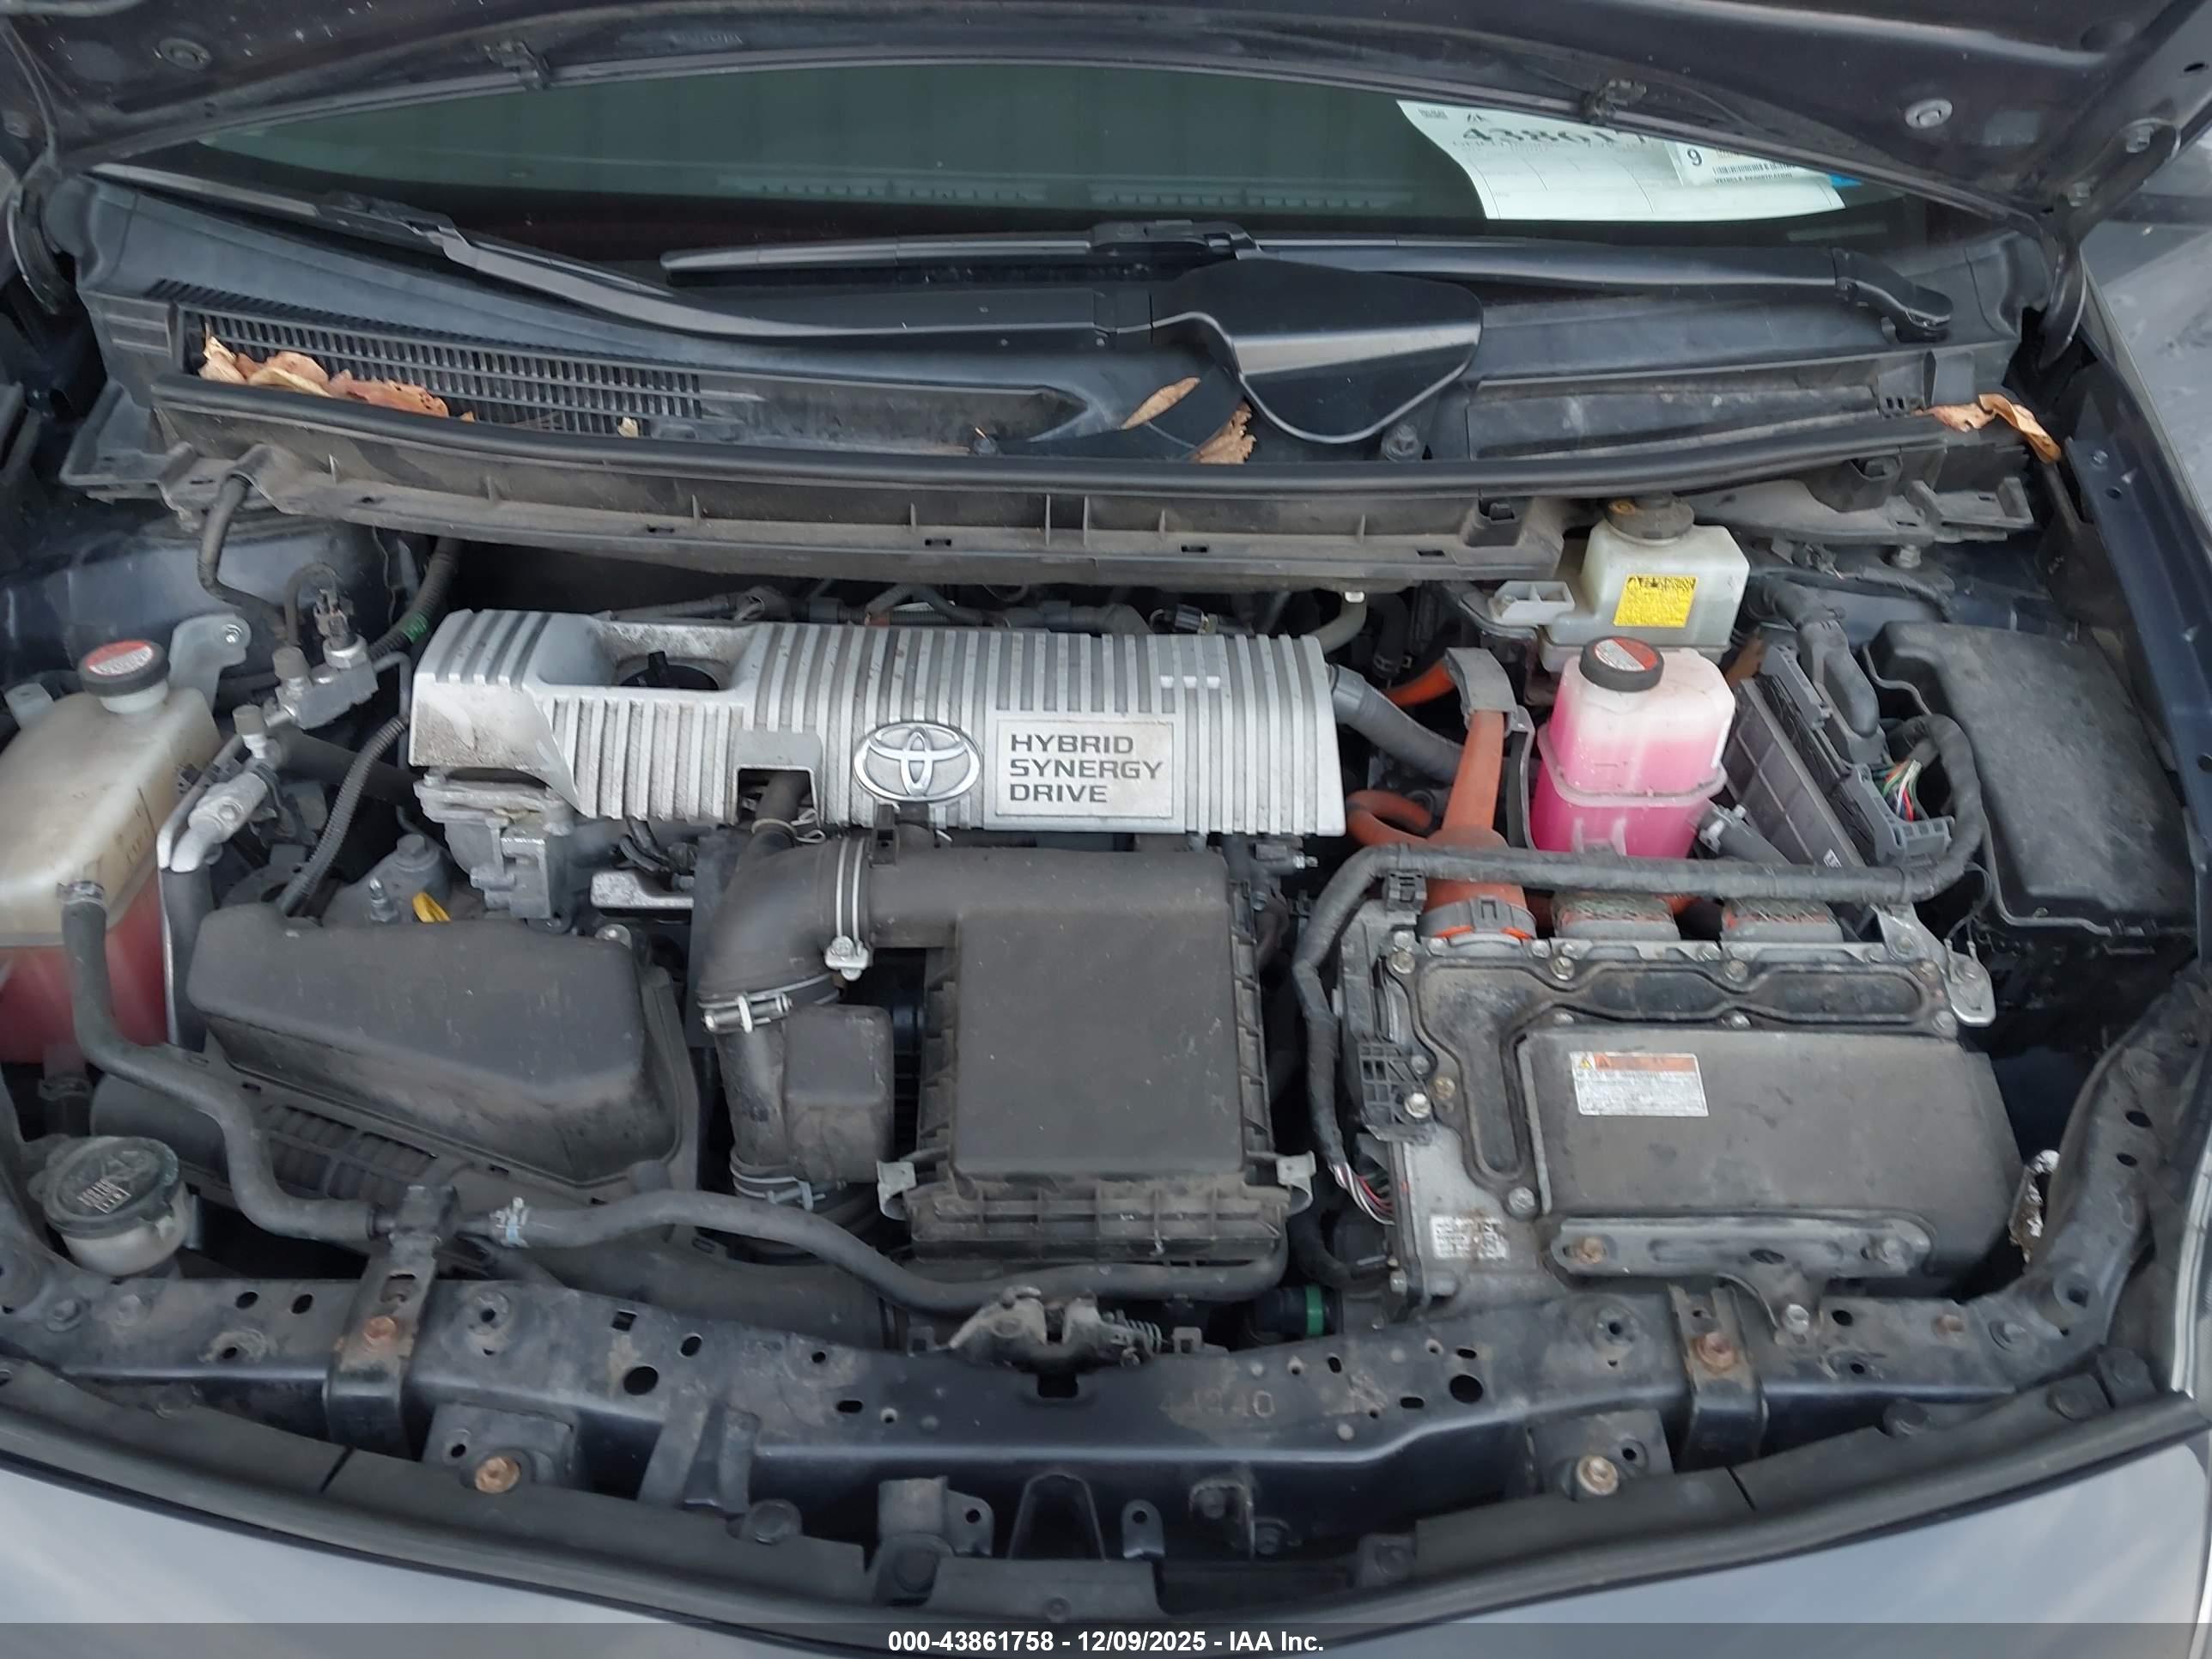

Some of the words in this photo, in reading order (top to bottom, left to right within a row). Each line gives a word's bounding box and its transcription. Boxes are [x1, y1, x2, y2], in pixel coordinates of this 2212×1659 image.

[1686, 149, 1703, 167] 9
[1010, 733, 1134, 754] HYBRID
[1009, 758, 1164, 780] SYNERGY
[1009, 783, 1108, 804] DRIVE
